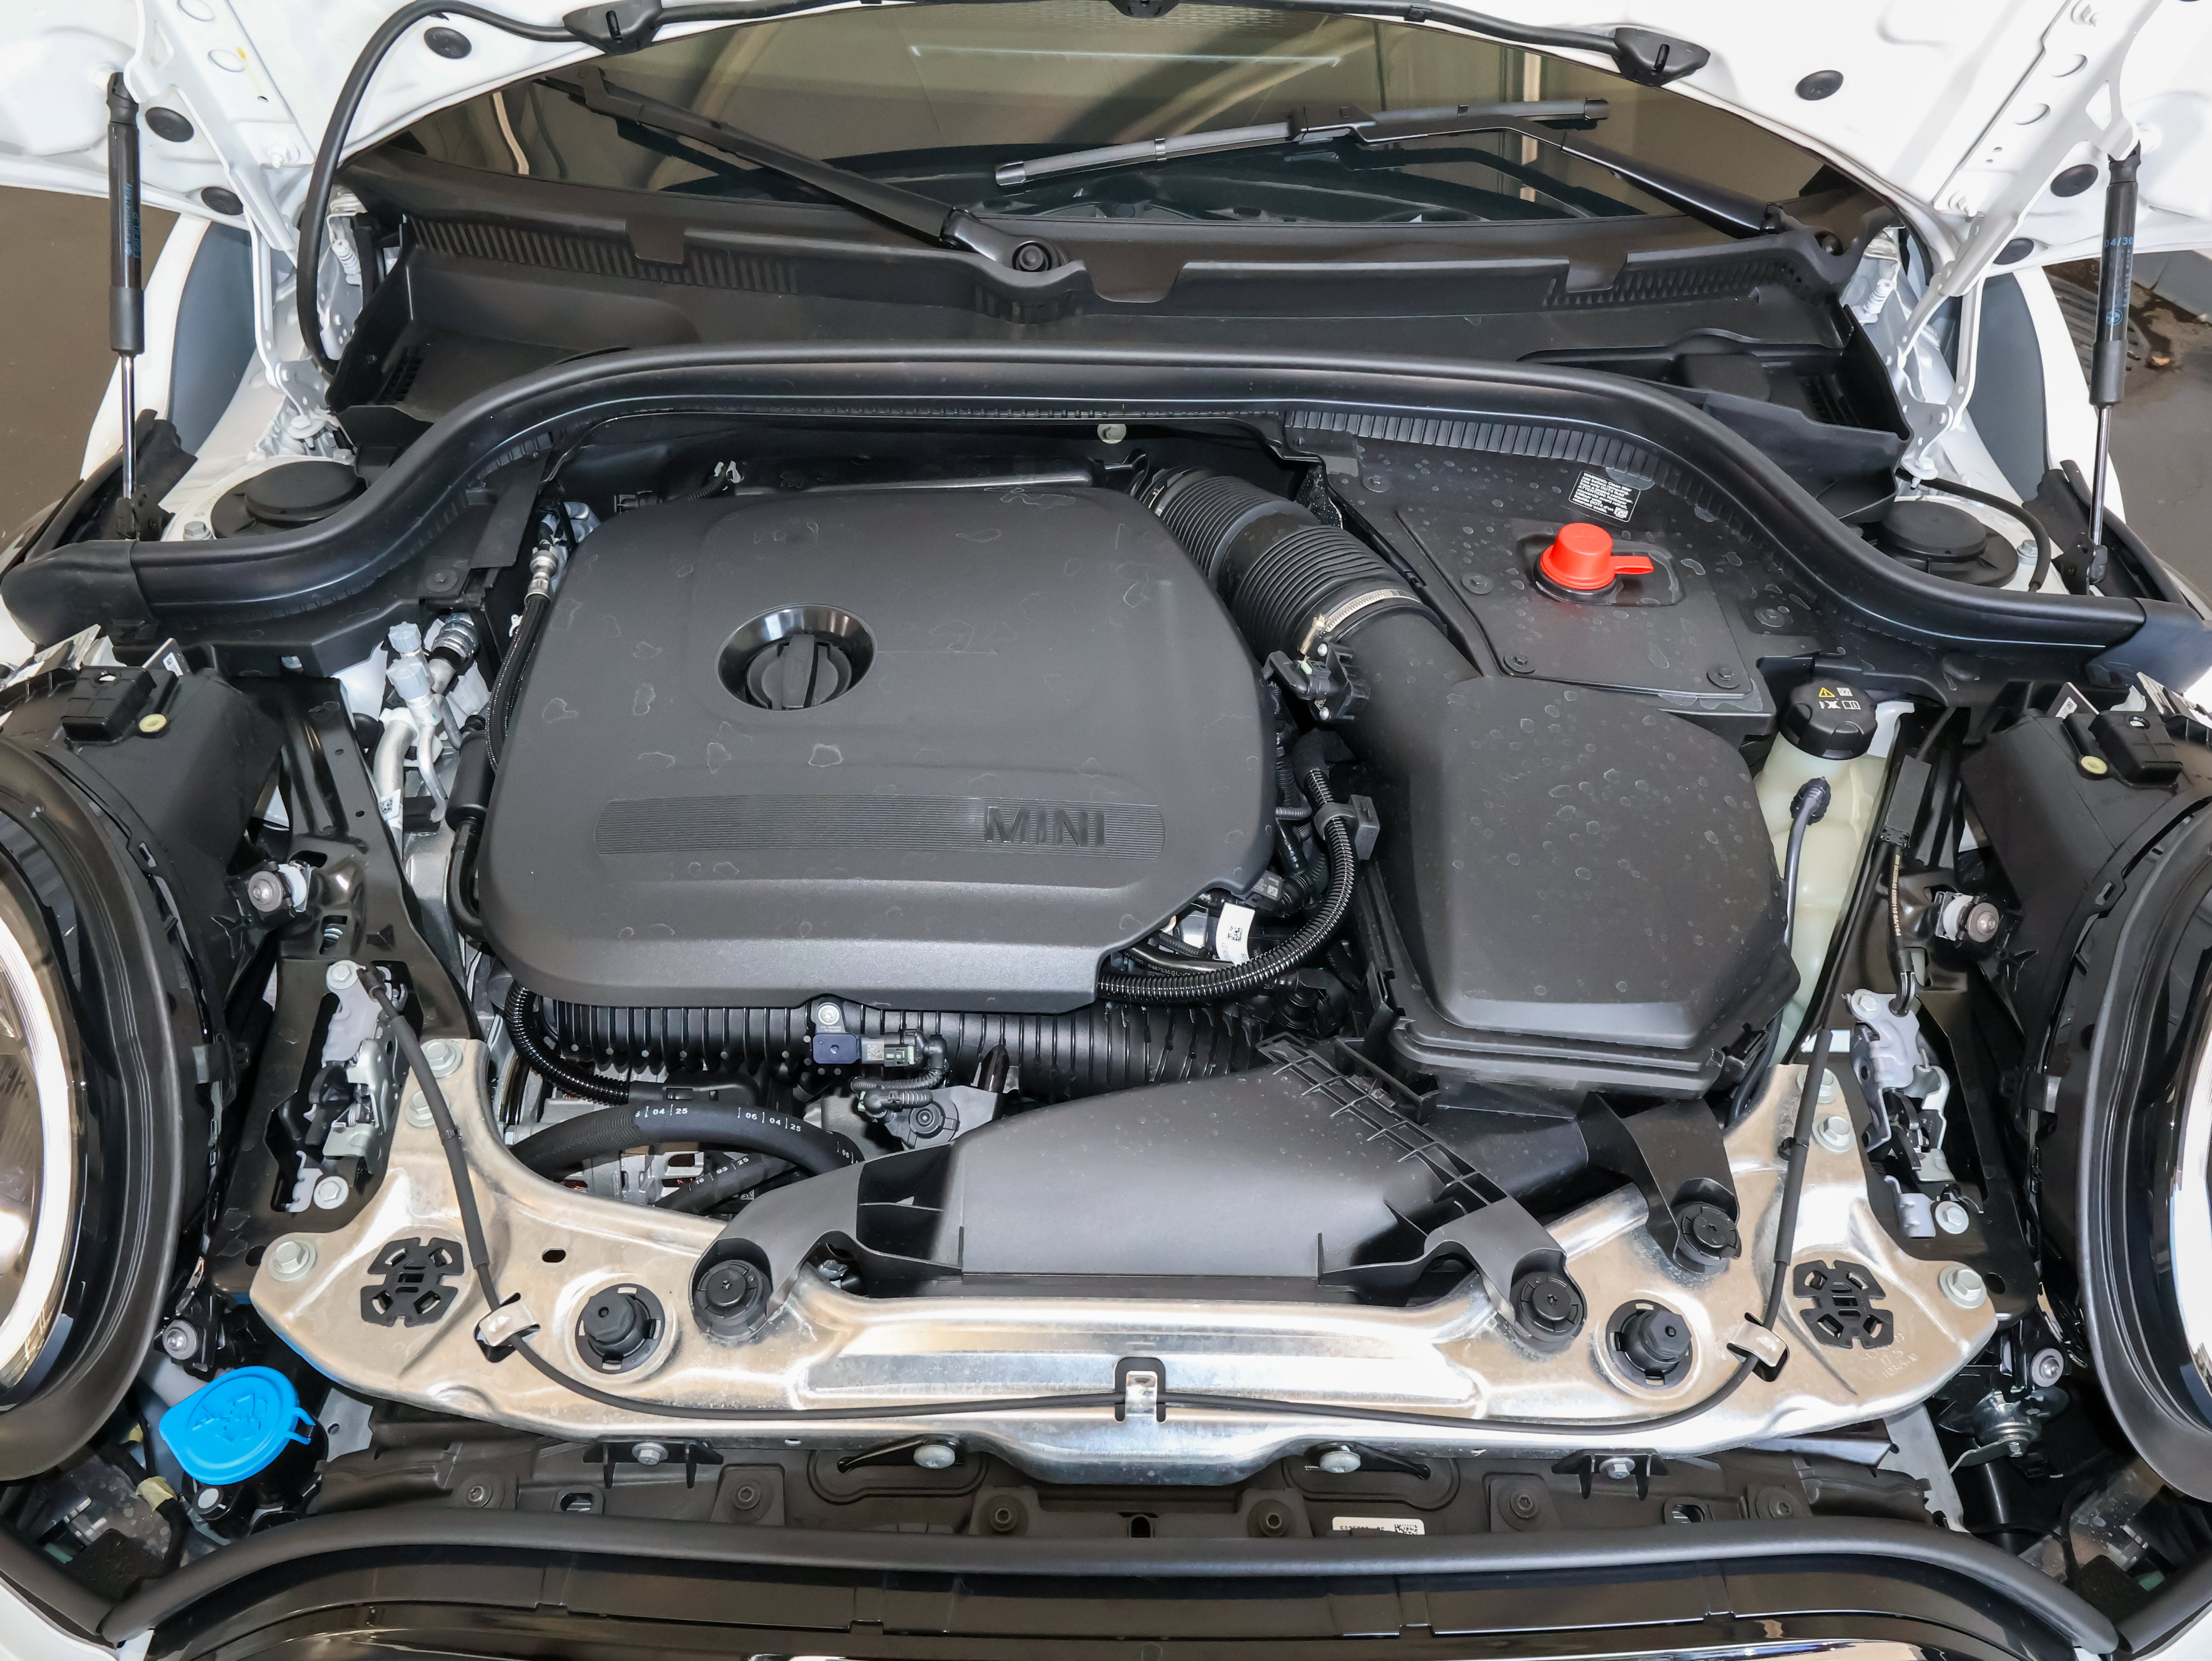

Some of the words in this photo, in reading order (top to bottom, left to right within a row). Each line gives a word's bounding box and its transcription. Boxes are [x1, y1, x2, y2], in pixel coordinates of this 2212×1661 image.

[1583, 473, 1608, 483] WARNING:
[1578, 485, 1606, 497] ATTENTION:
[984, 806, 1105, 846] MINI
[737, 1157, 749, 1166] 25
